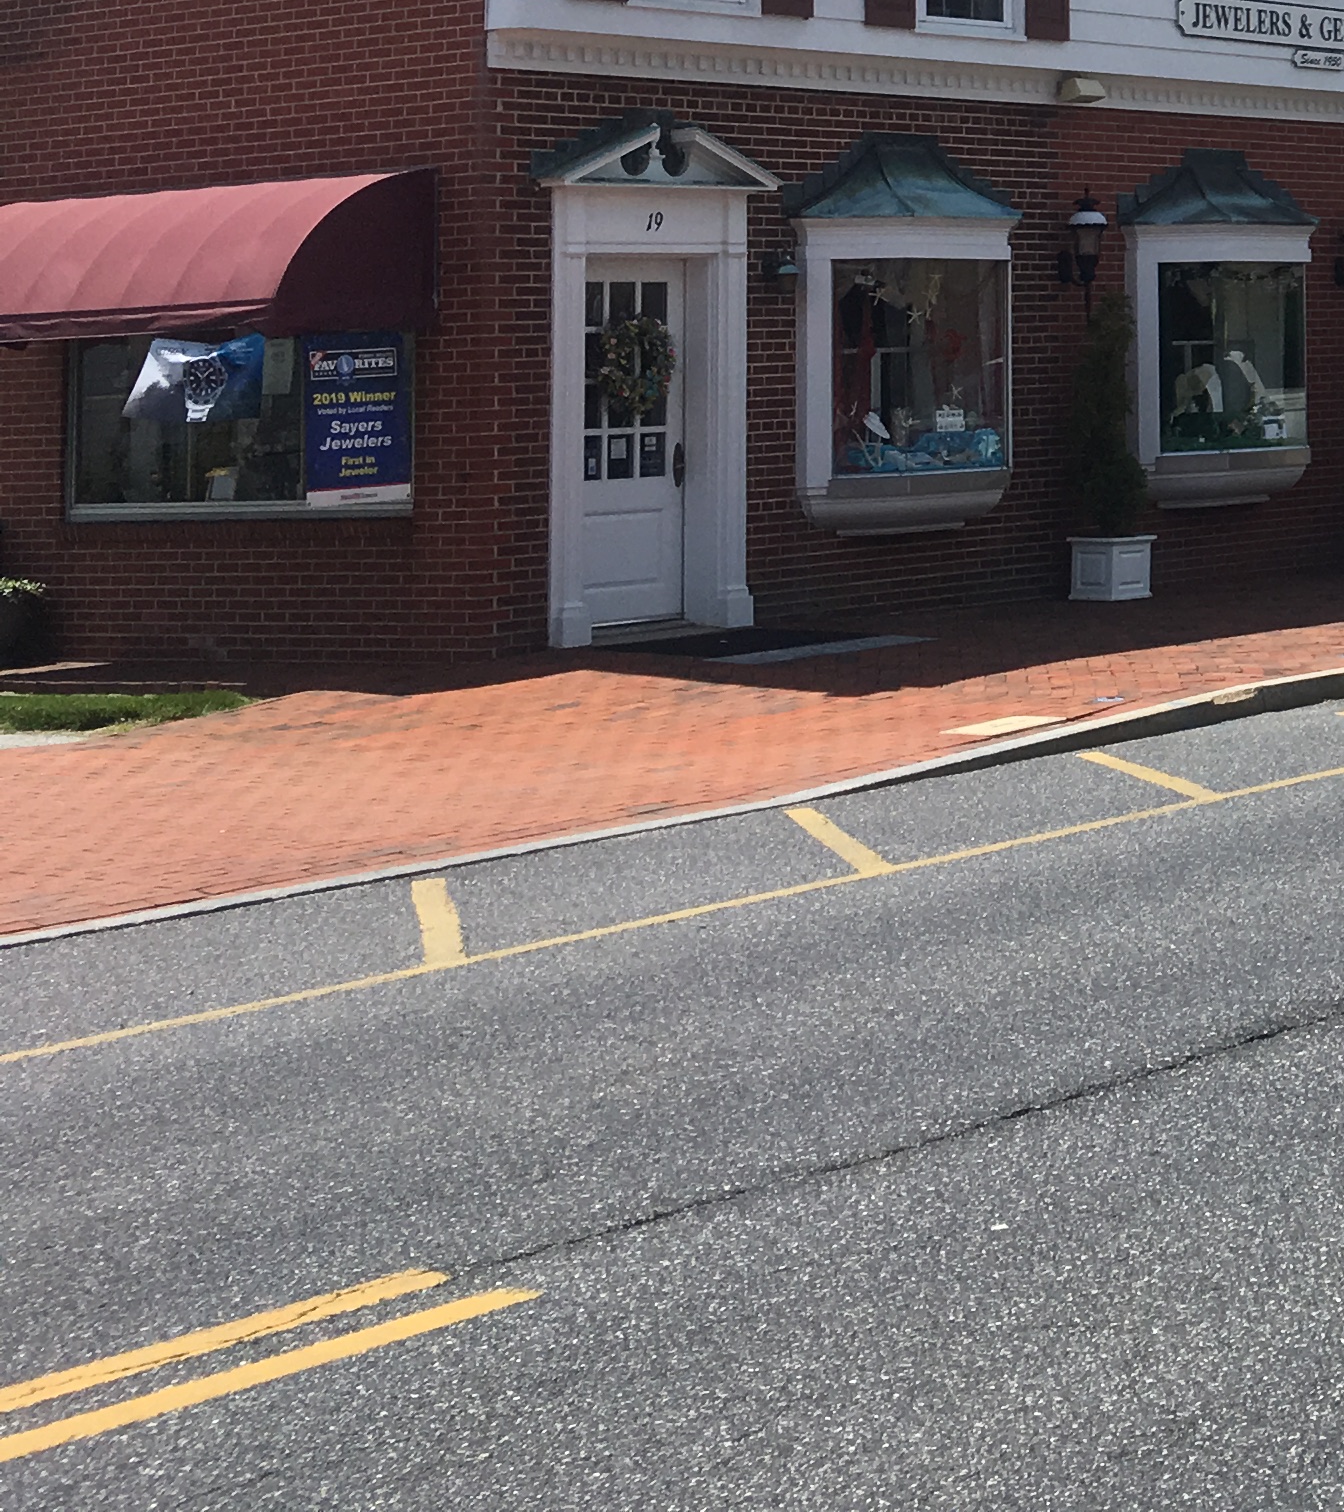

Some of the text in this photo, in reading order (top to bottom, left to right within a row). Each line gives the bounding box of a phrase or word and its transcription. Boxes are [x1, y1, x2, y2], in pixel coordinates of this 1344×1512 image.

[1192, 2, 1292, 37] JEWELERS
[1298, 13, 1314, 39] &
[1300, 53, 1321, 65] Since
[646, 211, 664, 232] 19
[312, 391, 396, 405] 2019 Winner
[338, 406, 347, 415] by
[347, 405, 366, 414] Local
[330, 420, 383, 436] Sayers
[319, 434, 392, 451] Jewelers
